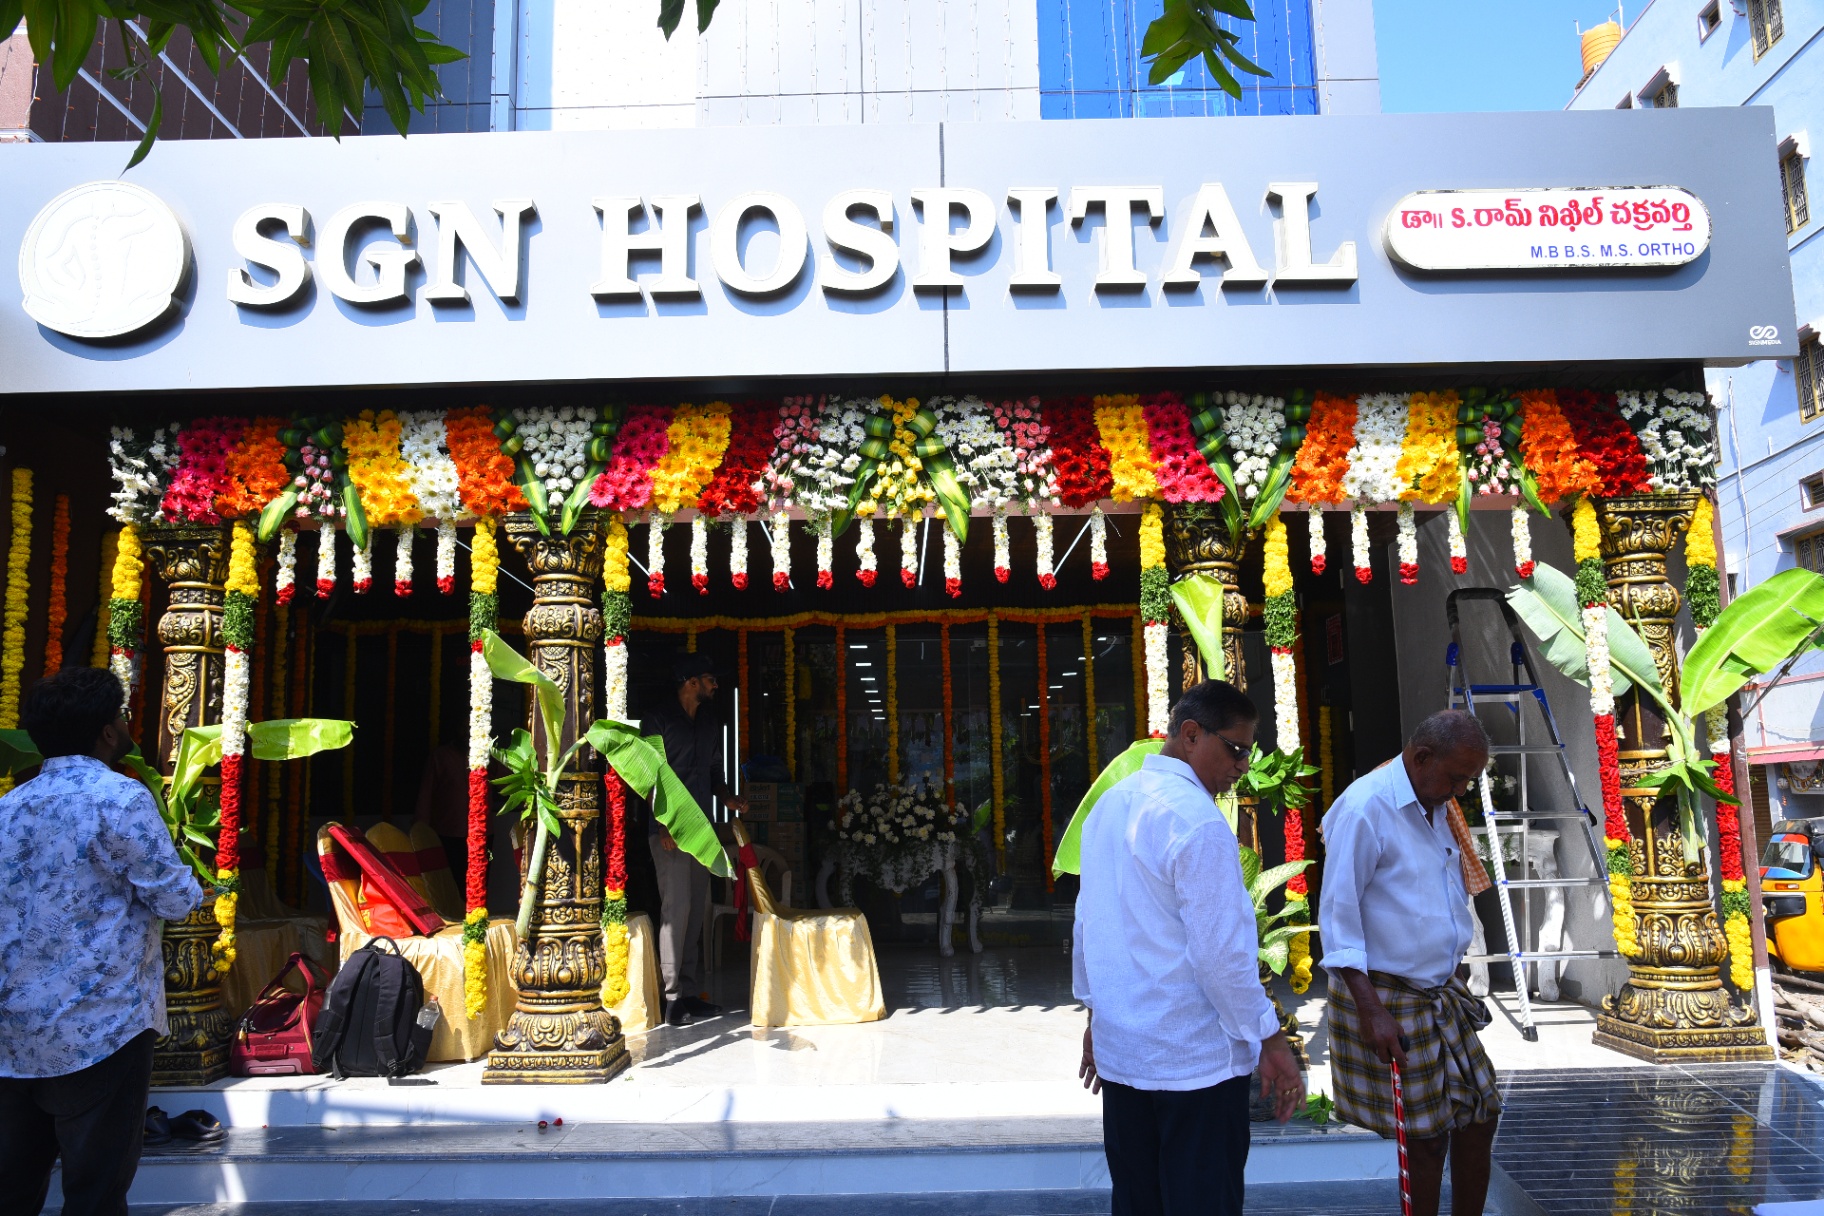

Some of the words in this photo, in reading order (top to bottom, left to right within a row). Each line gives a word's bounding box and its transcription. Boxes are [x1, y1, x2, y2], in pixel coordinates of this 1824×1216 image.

[1538, 196, 1604, 232] నిఖిల్
[1610, 198, 1693, 231] చక్రవర్తి
[227, 199, 537, 306] SGN
[591, 181, 1359, 298] HOSPITAL
[1600, 243, 1633, 258] M.S.
[1638, 241, 1695, 257] ORTHO
